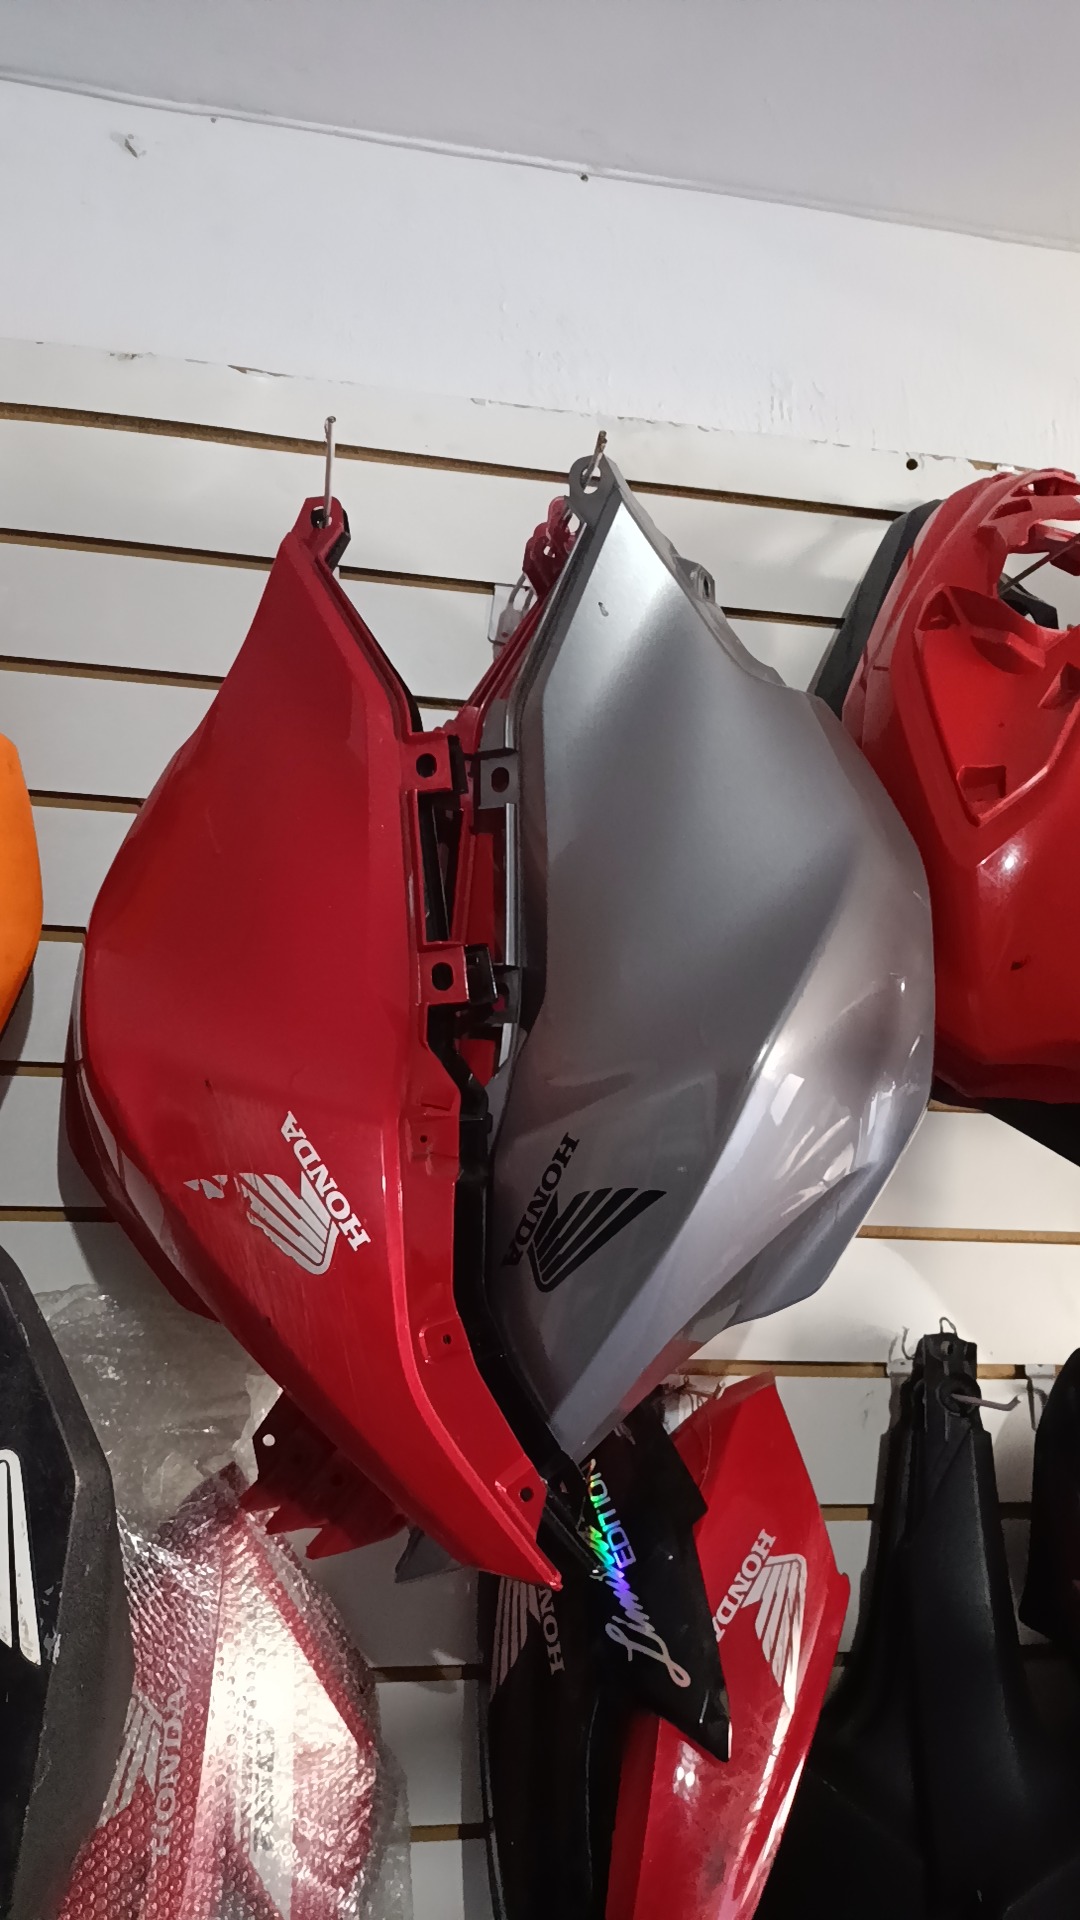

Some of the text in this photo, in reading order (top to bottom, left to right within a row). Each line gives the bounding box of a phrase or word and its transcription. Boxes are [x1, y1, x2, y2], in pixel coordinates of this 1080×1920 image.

[281, 1110, 371, 1251] HONDA
[502, 1132, 580, 1266] HONDA
[580, 1458, 637, 1569] EDITION
[538, 1586, 566, 1676] HON
[150, 1684, 188, 1864] HONDA
